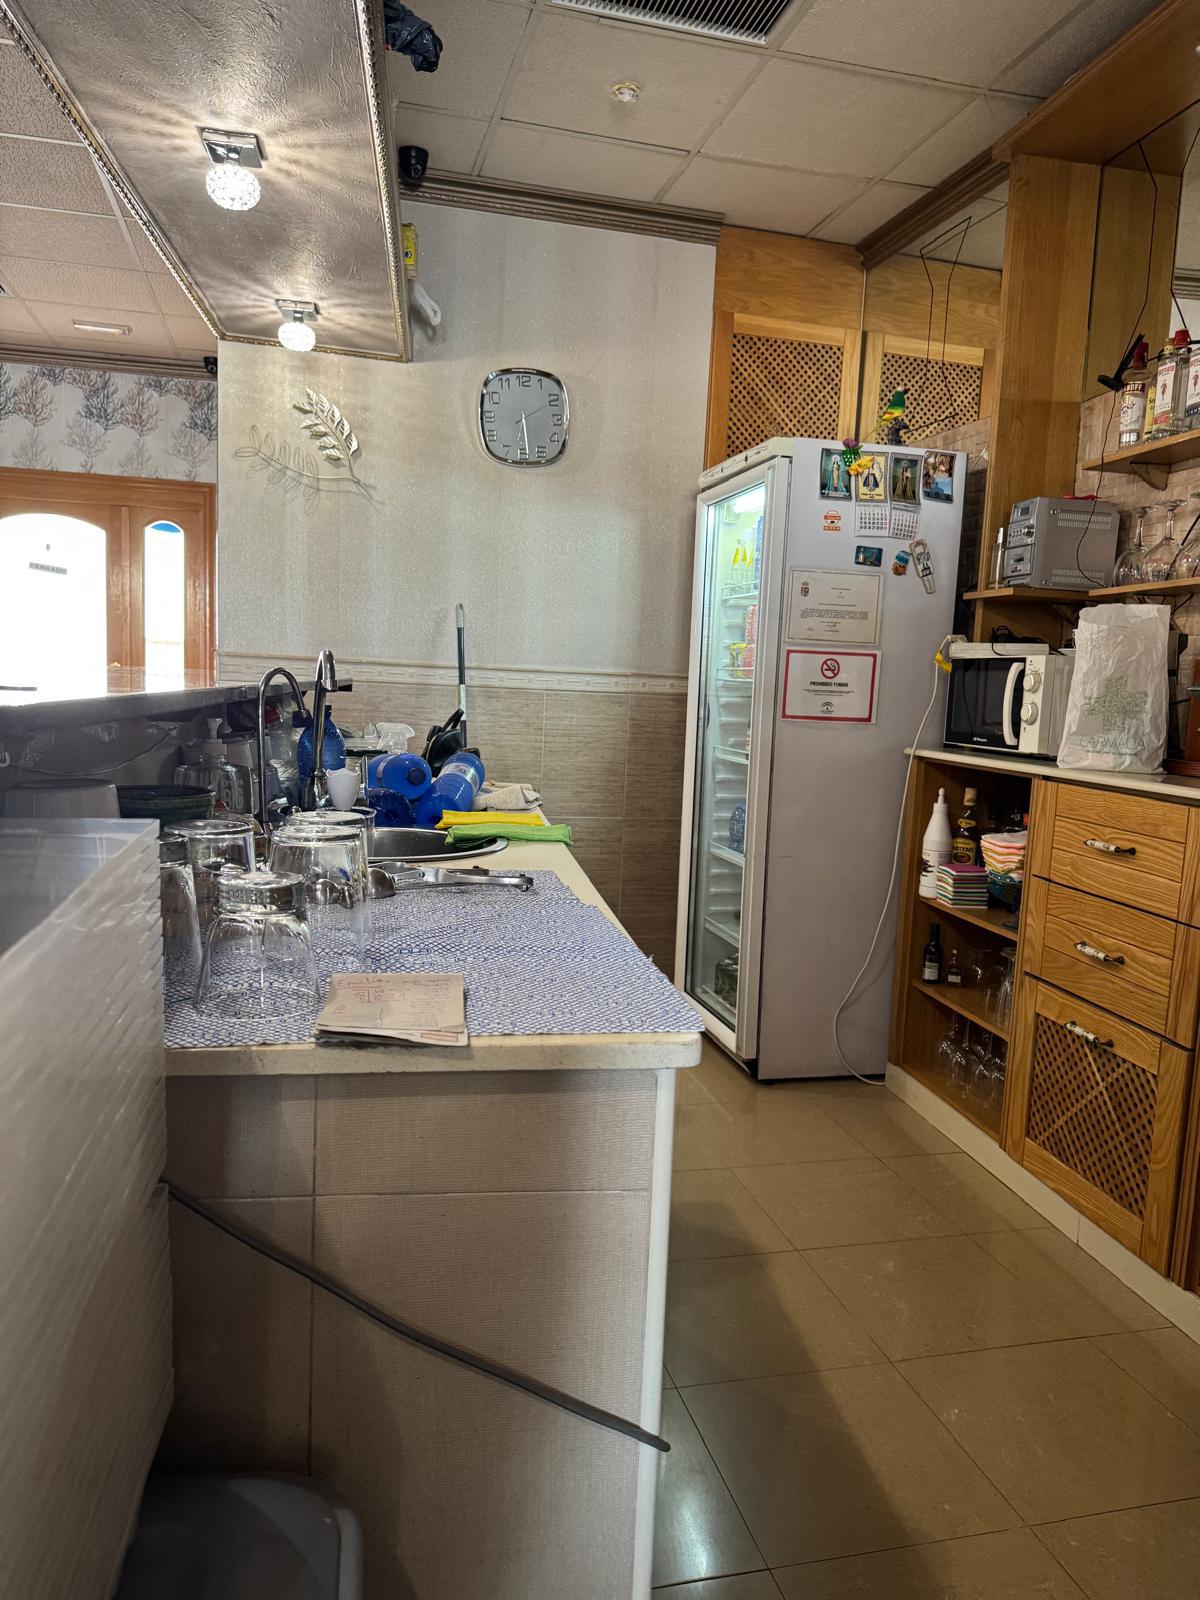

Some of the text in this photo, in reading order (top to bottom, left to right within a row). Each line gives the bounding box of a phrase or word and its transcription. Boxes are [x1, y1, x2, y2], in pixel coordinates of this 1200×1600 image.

[498, 377, 511, 390] 11
[516, 375, 531, 388] 12
[537, 378, 543, 391] 1
[486, 391, 500, 405] 10
[548, 393, 560, 407] 2
[484, 410, 496, 424] 9
[552, 413, 562, 427] 3
[486, 429, 497, 442] 8
[548, 432, 560, 445] 4
[501, 443, 512, 457] 7
[518, 448, 529, 460] 6
[535, 445, 547, 458] 5
